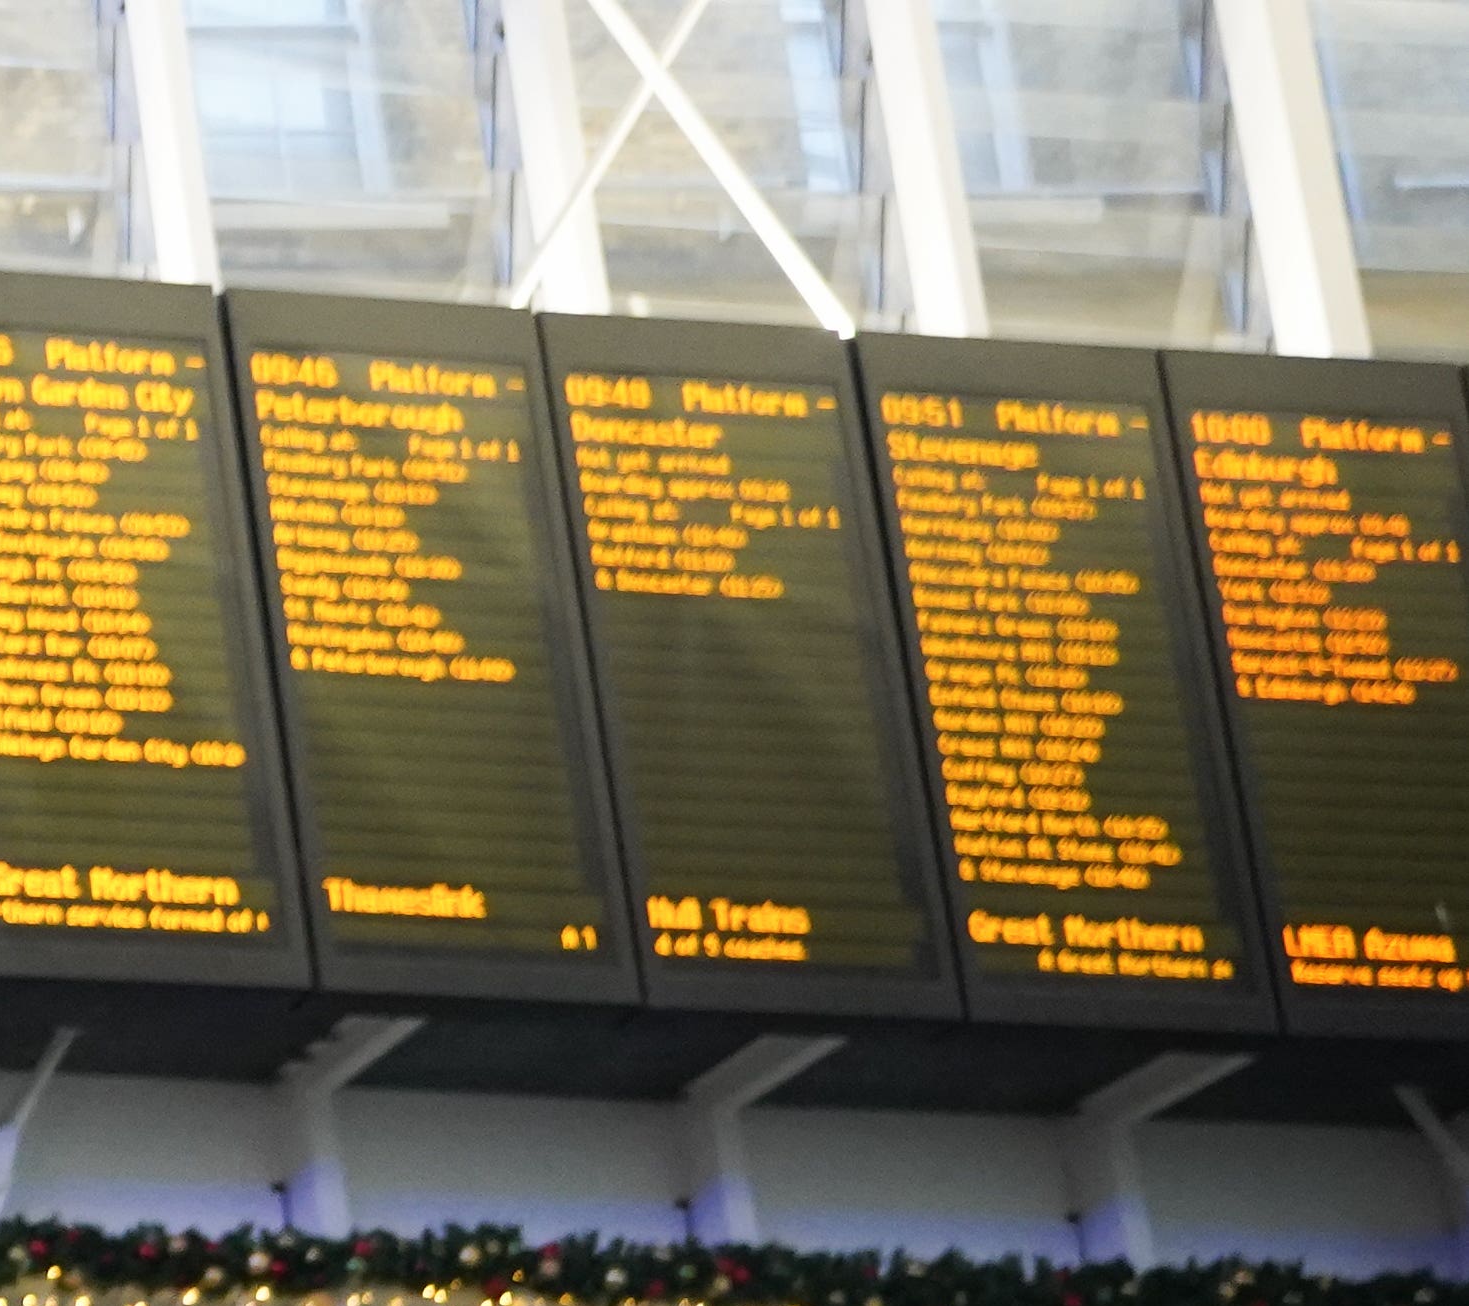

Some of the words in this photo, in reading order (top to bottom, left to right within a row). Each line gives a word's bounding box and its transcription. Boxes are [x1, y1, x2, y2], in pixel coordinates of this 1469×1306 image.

[45, 340, 176, 375] Platform
[30, 374, 130, 410] Garden
[369, 362, 496, 397] Platform
[255, 390, 464, 435] Peterborough
[681, 381, 808, 417] Platform
[570, 411, 723, 449] Doncaster
[996, 402, 1119, 436] Platform
[1299, 418, 1425, 453] Platform
[887, 431, 1038, 470] Stevenage
[1194, 448, 1338, 485] Edinburgh
[88, 866, 241, 906] Northern
[323, 877, 486, 918] Thameslink
[709, 898, 811, 934] Trains
[968, 911, 1054, 946] Great
[1063, 916, 1204, 952] Northern
